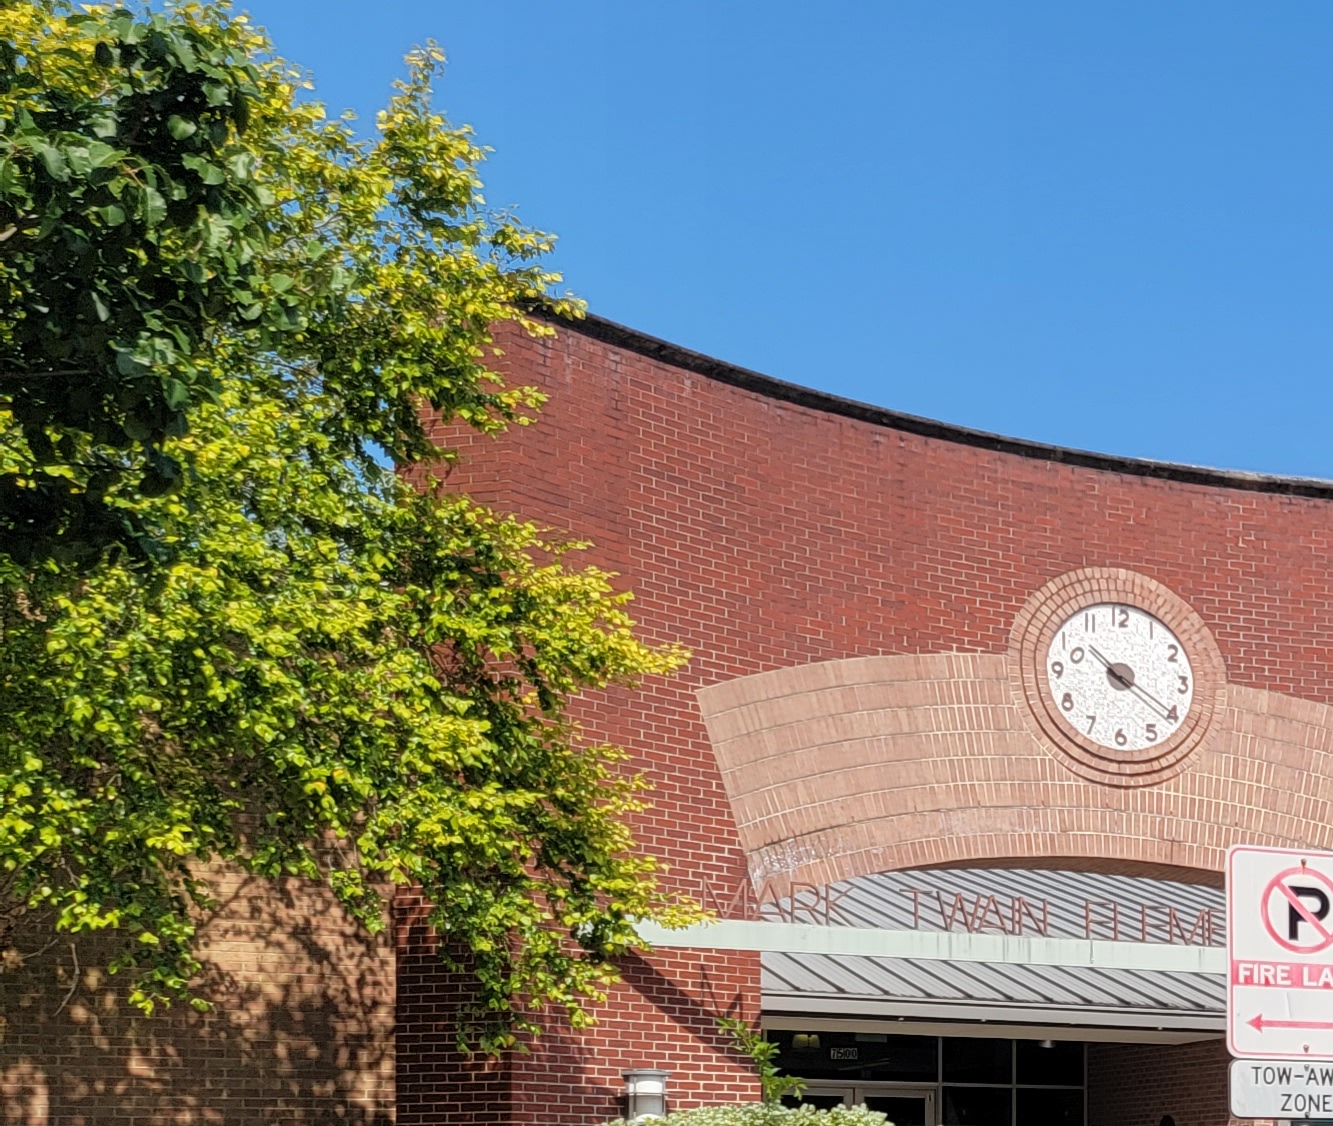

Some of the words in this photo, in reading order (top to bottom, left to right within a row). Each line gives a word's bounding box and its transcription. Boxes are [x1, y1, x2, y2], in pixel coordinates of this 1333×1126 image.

[1085, 613, 1095, 633] 11
[1112, 606, 1129, 628] 12
[1167, 644, 1178, 663] 2
[1051, 661, 1064, 680] 9
[1177, 675, 1189, 695] 3
[1061, 692, 1074, 712] 8
[1166, 704, 1179, 724] 4
[1086, 715, 1096, 735] 7
[1145, 724, 1158, 742] 5
[1114, 728, 1127, 747] 6
[702, 876, 855, 928] MARK
[899, 887, 1048, 937] TWAIN
[1085, 899, 1227, 947] ELEME
[1287, 885, 1330, 941] P
[1238, 963, 1292, 986] FIRE
[832, 1048, 857, 1059] 7500
[1280, 1094, 1333, 1113] ZONE
